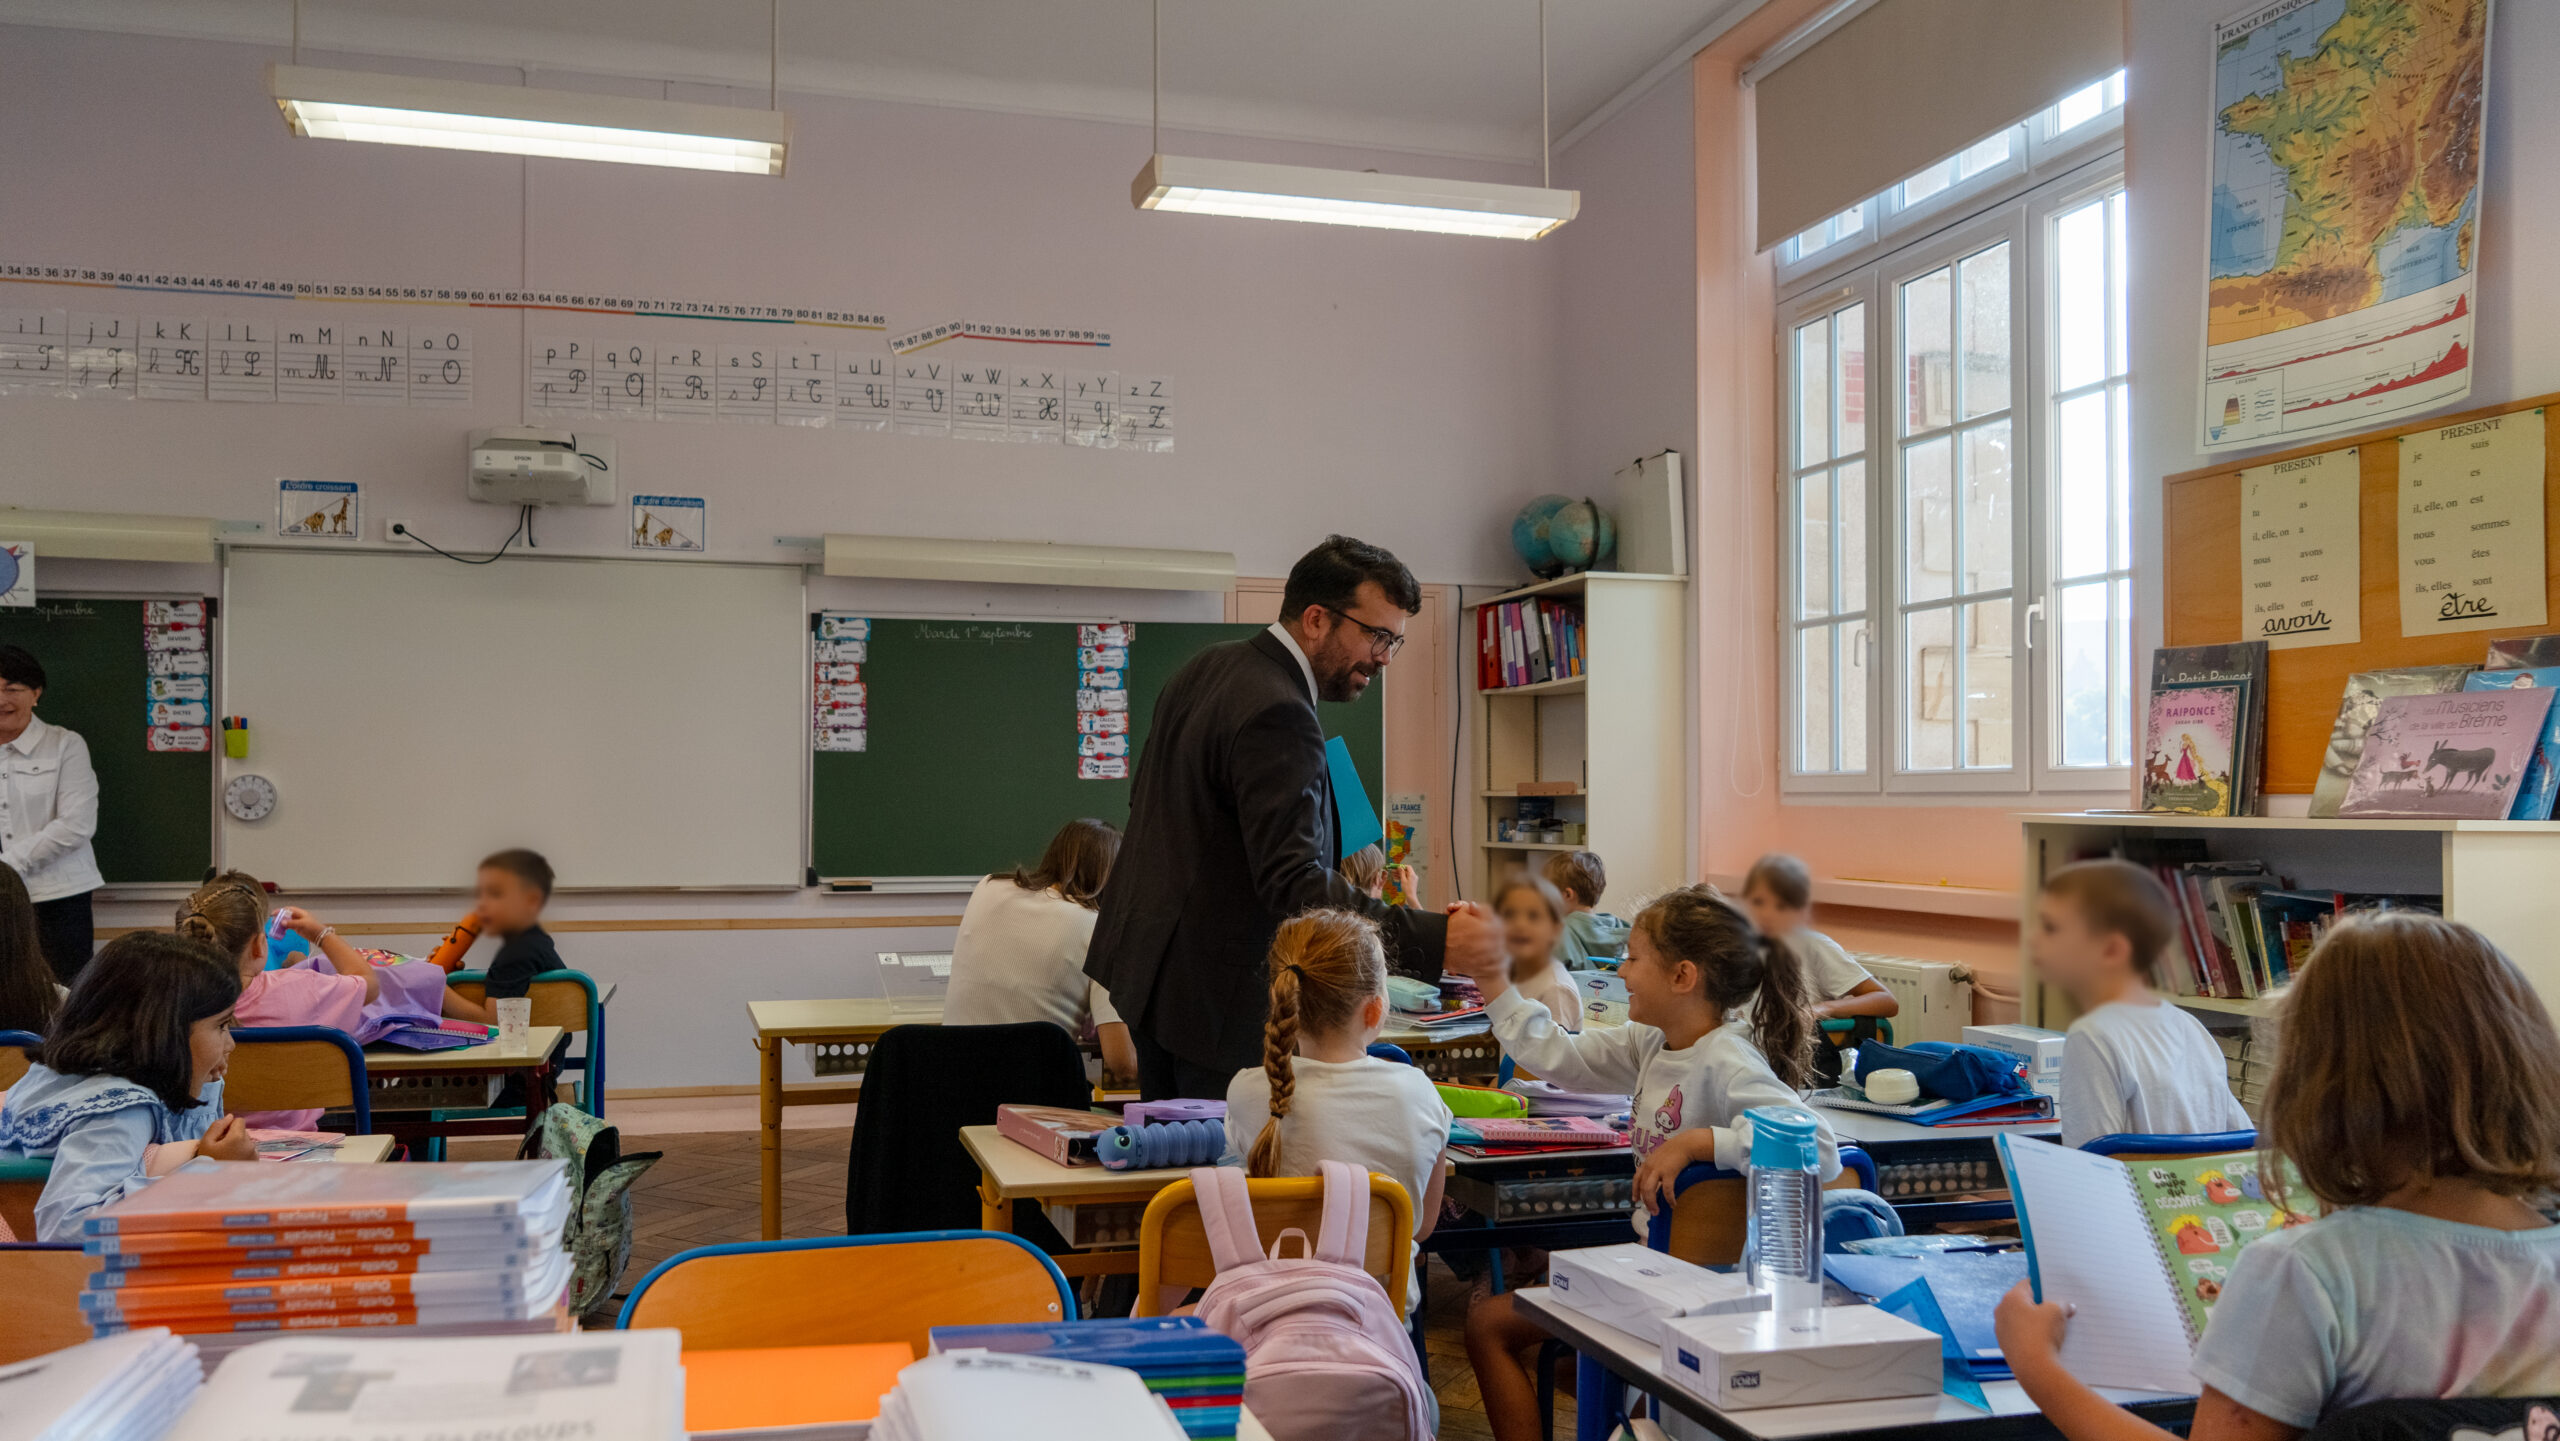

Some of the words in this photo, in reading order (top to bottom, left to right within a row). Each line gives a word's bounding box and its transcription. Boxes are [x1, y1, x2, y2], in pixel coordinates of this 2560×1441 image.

[2221, 16, 2260, 41] FRANCE
[2261, 0, 2307, 22] PHYSIQ
[7, 265, 22, 276] 34
[25, 266, 41, 277] 35
[44, 267, 59, 278] 36
[62, 268, 77, 279] 37
[81, 270, 96, 280] 38
[99, 271, 115, 282] 39
[118, 273, 133, 283] 40
[136, 274, 150, 284] 41
[154, 275, 169, 286] 42
[172, 276, 187, 286] 43
[190, 277, 205, 287] 44
[208, 278, 224, 289] 45
[225, 279, 241, 289] 46
[243, 280, 258, 290] 47
[261, 281, 276, 292] 48
[2440, 419, 2502, 441] PRESENT
[2412, 451, 2423, 463] je
[2470, 438, 2490, 450] suis
[2273, 455, 2325, 475] PRESENT
[2412, 479, 2423, 488] tu
[2470, 468, 2481, 478] es
[2445, 499, 2459, 510] on
[2469, 494, 2484, 505] est
[2279, 528, 2289, 538] on
[2413, 529, 2436, 541] nous
[2470, 518, 2511, 532] sommes
[2253, 556, 2272, 565] nous
[2299, 548, 2324, 559] avons
[2414, 556, 2437, 567] vous
[2471, 548, 2491, 560] êtes
[2254, 580, 2272, 590] vous
[2300, 573, 2320, 583] avez
[2430, 580, 2453, 592] elles
[2471, 576, 2493, 587] sont
[2267, 602, 2285, 613] elles
[2300, 599, 2314, 608] ont
[2440, 591, 2495, 618] être
[2261, 608, 2332, 635] avoir
[913, 623, 960, 640] Mardi
[980, 624, 1034, 646] septembre
[2166, 705, 2217, 718] RAIPONCE
[2436, 700, 2505, 715] Musiciens
[1391, 803, 1399, 811] LA
[1400, 803, 1421, 811] FRANCE
[2154, 1171, 2178, 1181] Une
[1553, 1275, 1570, 1291] TORK
[1731, 1371, 1761, 1389] TORK
